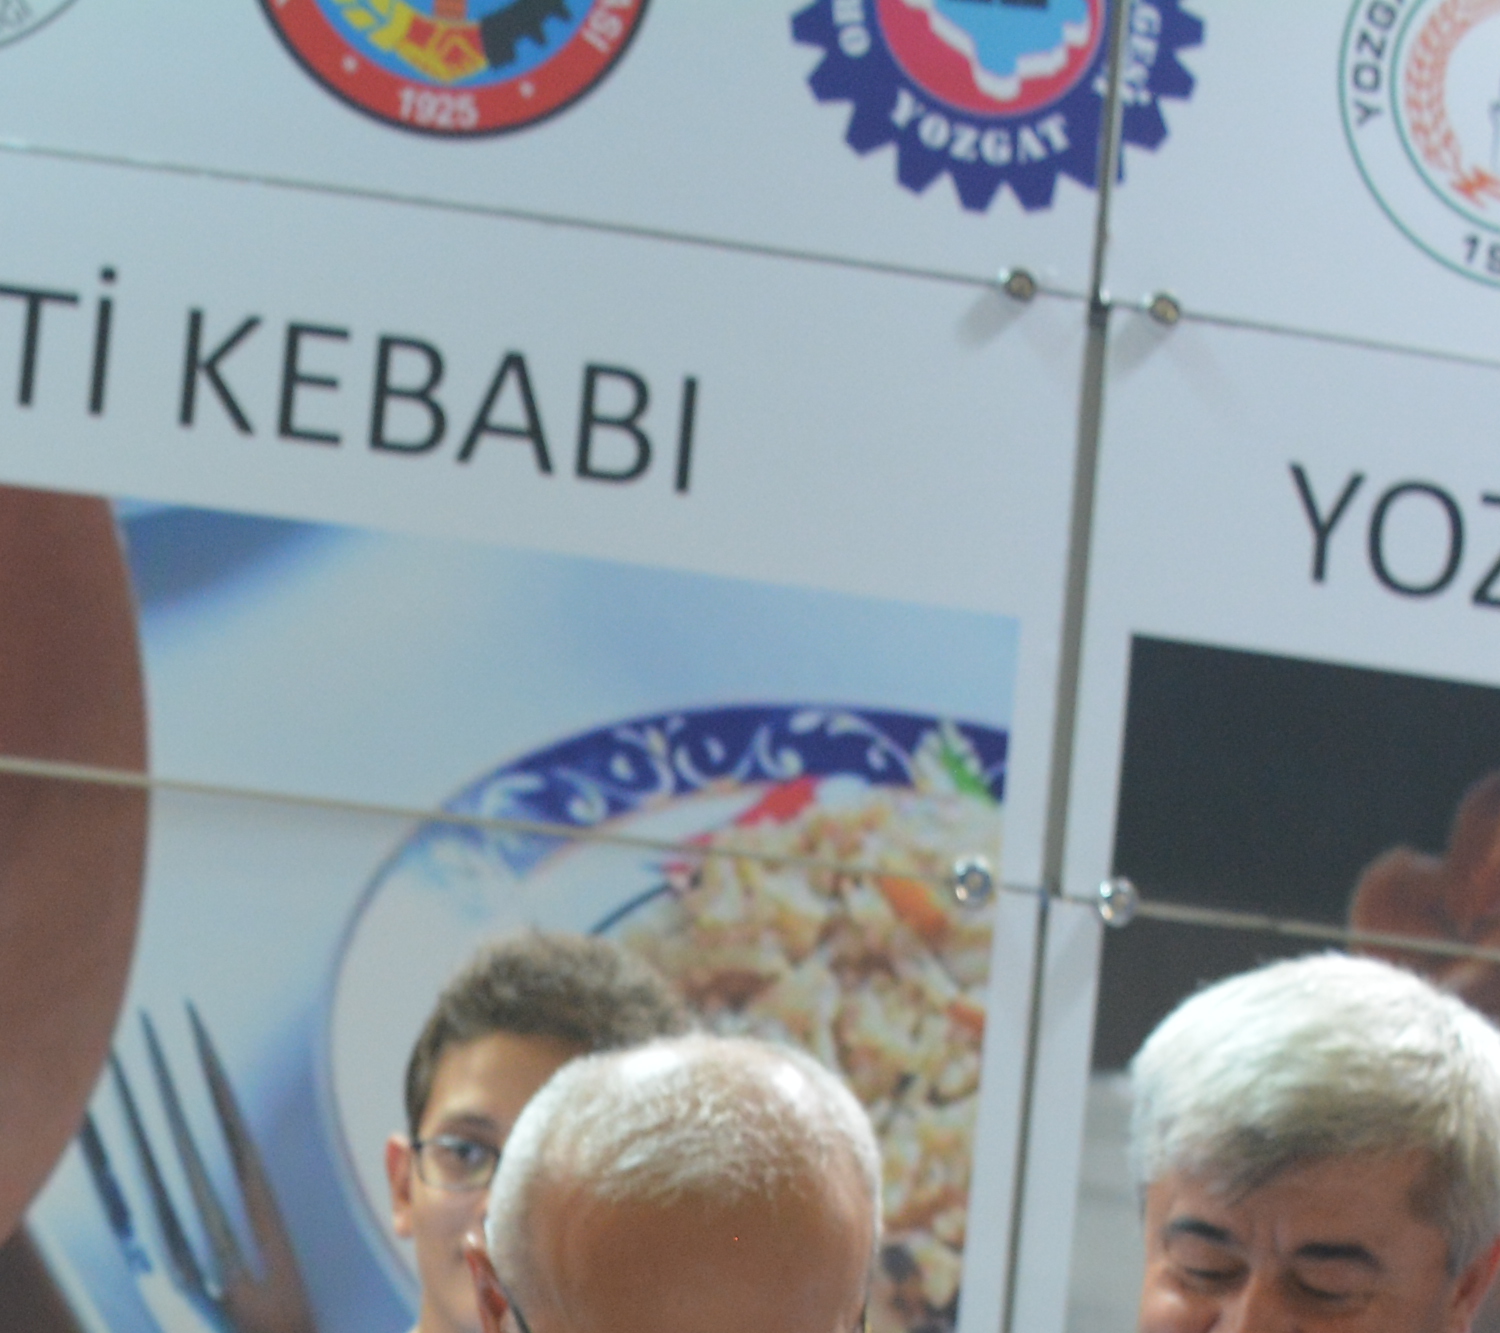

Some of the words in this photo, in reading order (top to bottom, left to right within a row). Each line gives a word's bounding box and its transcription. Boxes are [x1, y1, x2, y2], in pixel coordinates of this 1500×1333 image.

[400, 88, 478, 128] 1925
[1354, 0, 1403, 128] YOZG
[891, 88, 1069, 164] YOZGAT
[178, 308, 699, 495] KEBABI
